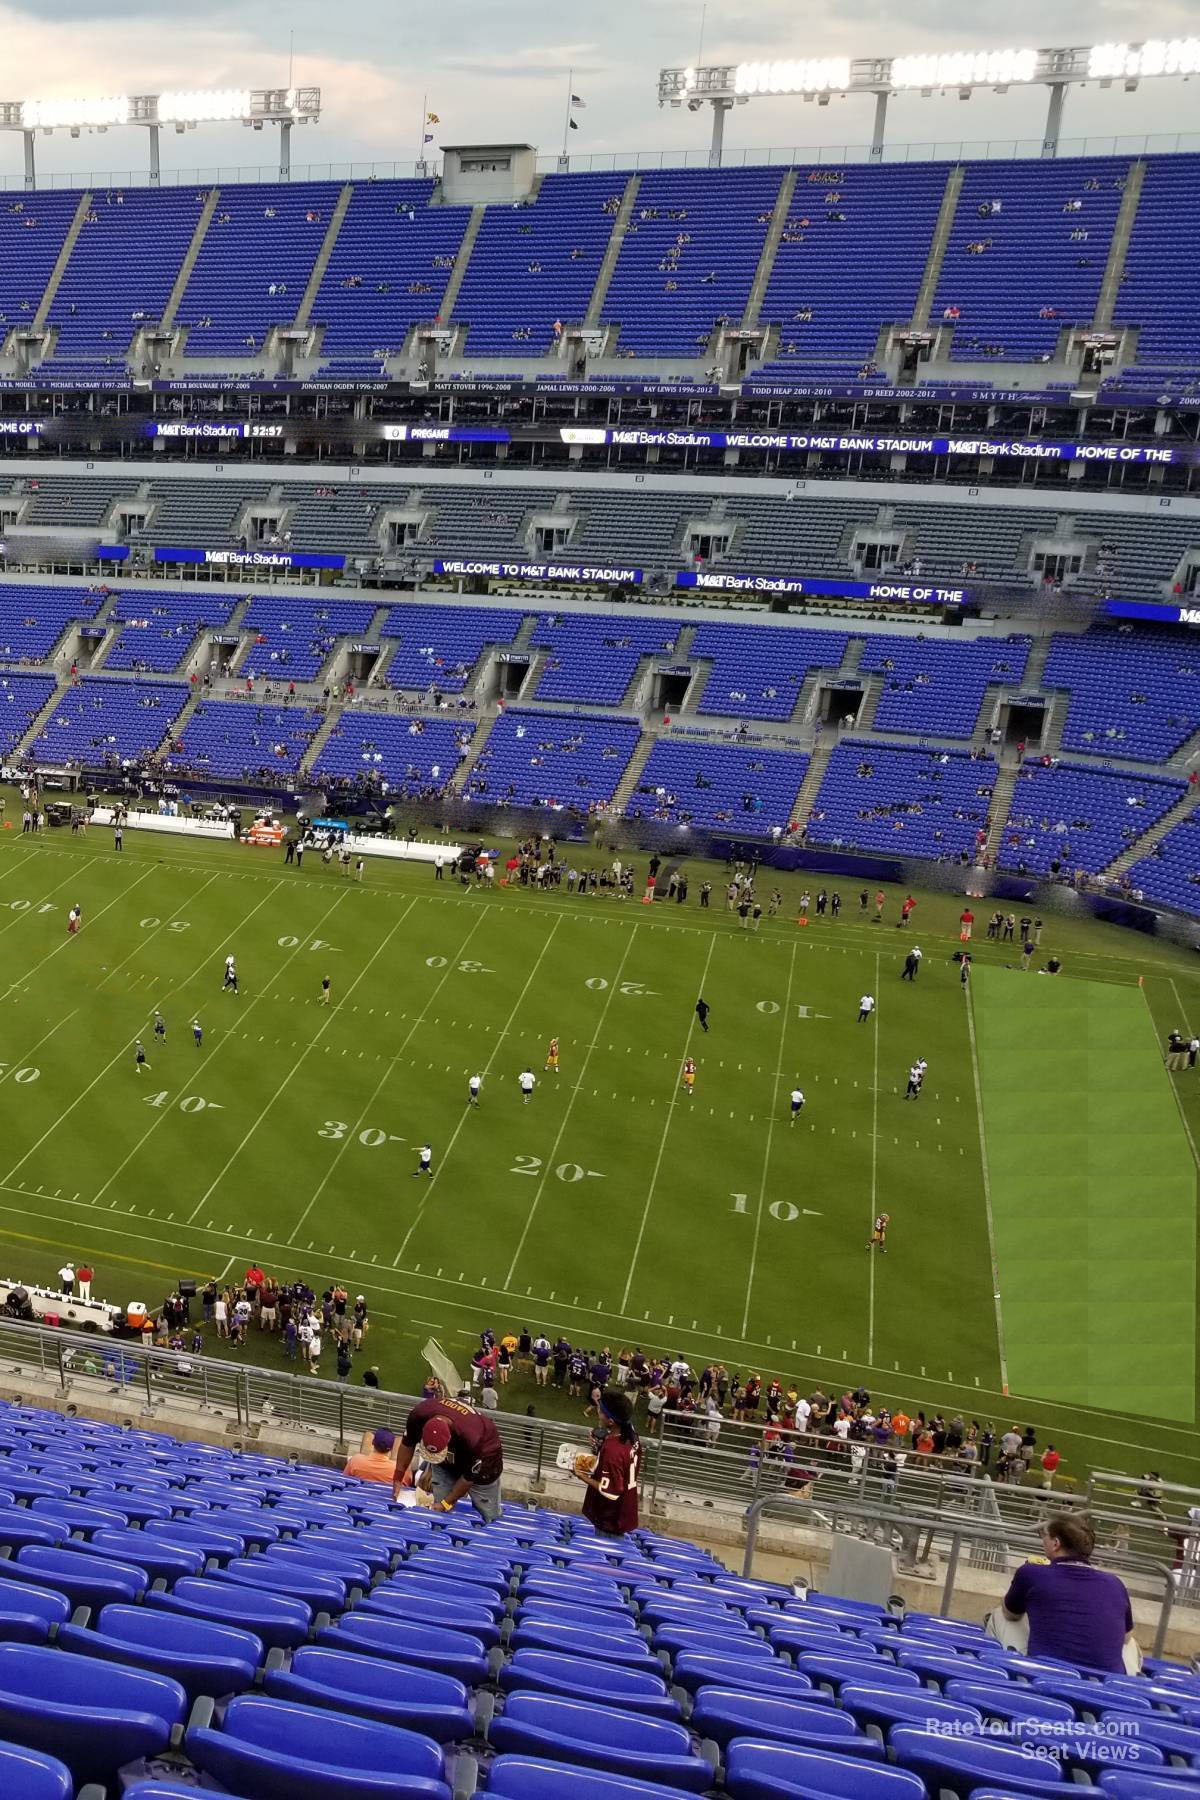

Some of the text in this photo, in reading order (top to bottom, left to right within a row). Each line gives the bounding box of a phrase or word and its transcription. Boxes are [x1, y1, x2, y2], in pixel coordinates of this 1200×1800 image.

[972, 392, 1015, 401] SMYTH
[19, 423, 32, 434] OF
[157, 425, 239, 437] M&T Bank Stadium
[411, 429, 449, 440] PREGAME
[612, 430, 710, 445] M&T Bank Stadium
[726, 433, 932, 452] WELCOME TO M&T BANK STADIUM
[948, 440, 1061, 456] M&T Bank Stadium
[1076, 443, 1172, 458] HOME OF THE
[206, 550, 292, 566] M&T Bank Stadium
[442, 561, 634, 582] WELCOME TO M&T BANK STADIUM
[696, 574, 802, 592] M&T Bank Stadium
[870, 586, 962, 602] HOME OF THE
[10, 900, 59, 914] 40
[140, 918, 191, 932] 50
[278, 936, 332, 952] 40
[426, 956, 484, 973] 30
[585, 977, 646, 995] 20
[756, 1000, 814, 1019] 10
[142, 1091, 206, 1113] 40
[317, 1120, 386, 1146] 30
[509, 1154, 585, 1182] 20
[728, 1193, 800, 1222] 10
[440, 1398, 468, 1416] DADDY
